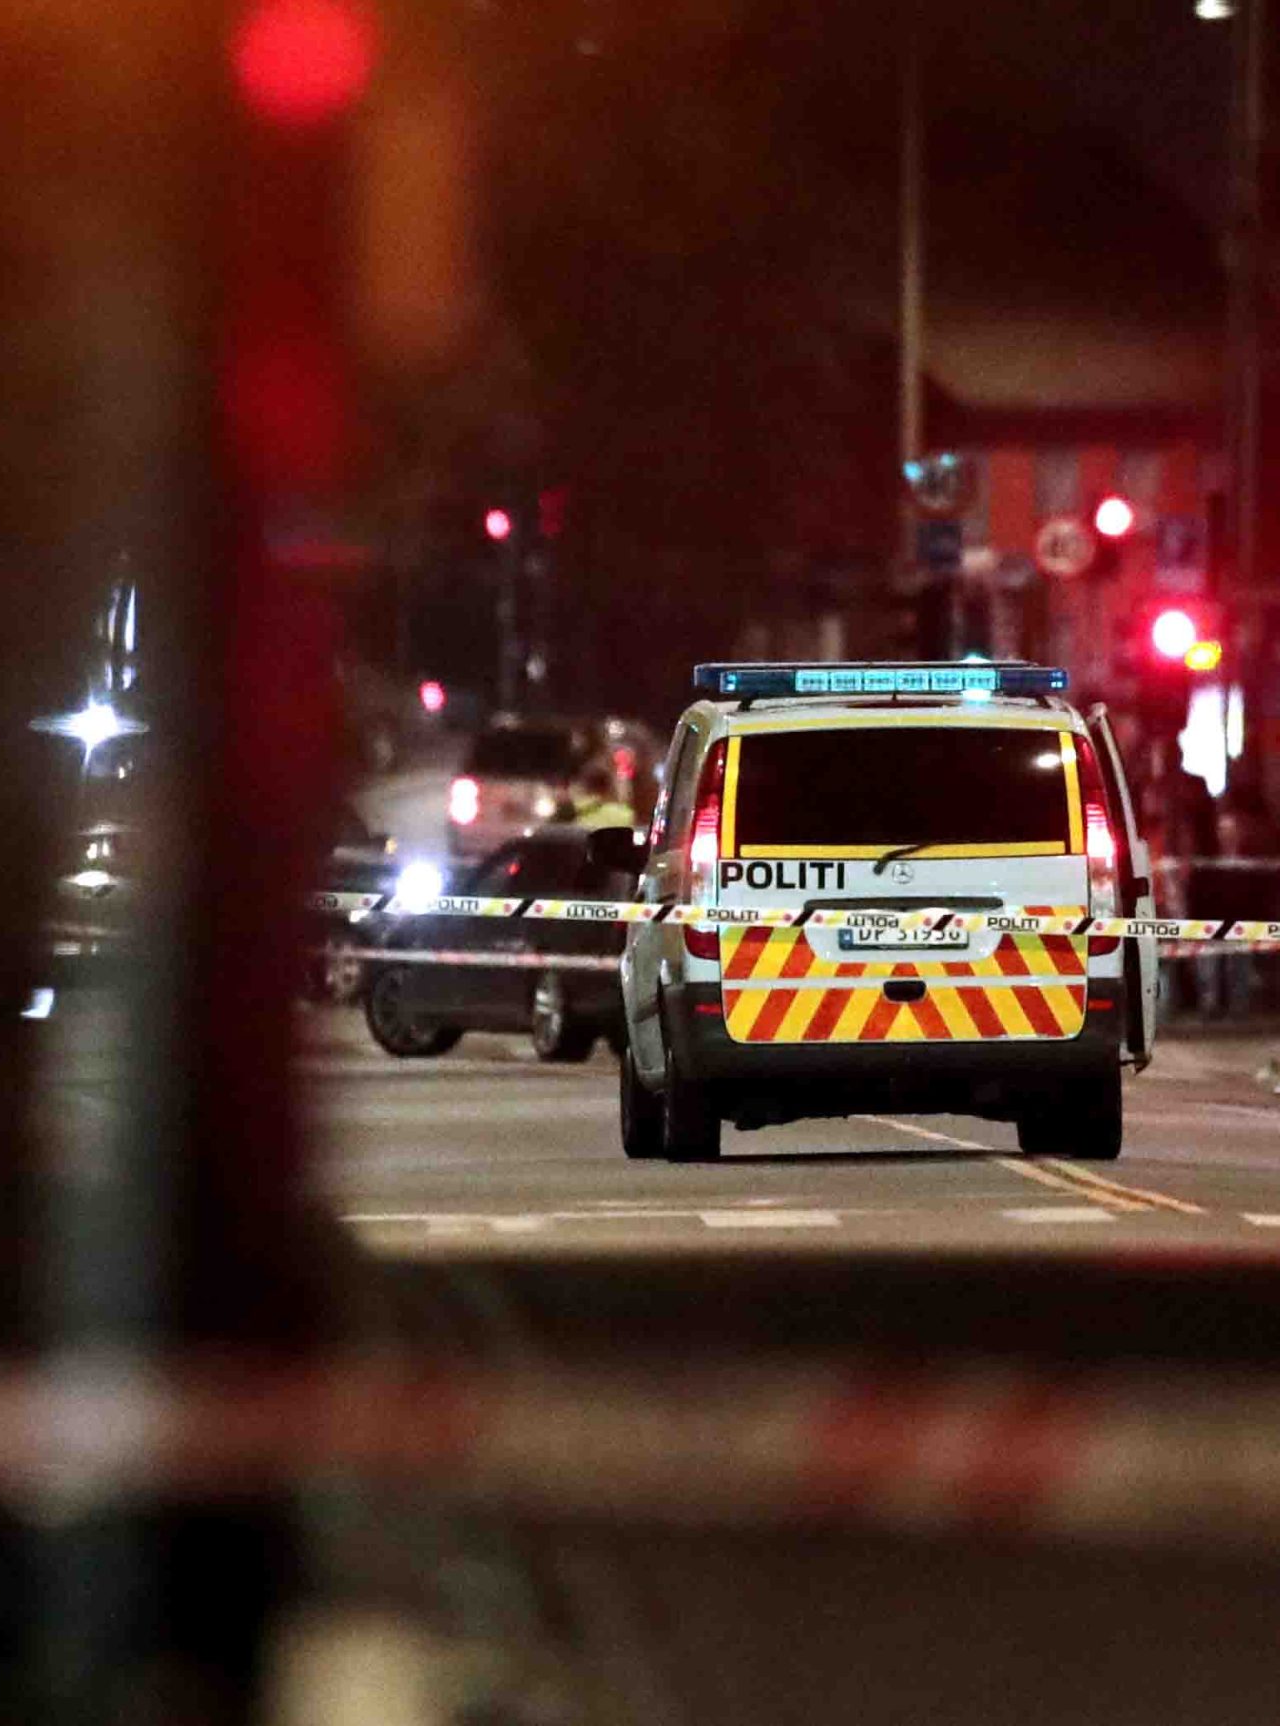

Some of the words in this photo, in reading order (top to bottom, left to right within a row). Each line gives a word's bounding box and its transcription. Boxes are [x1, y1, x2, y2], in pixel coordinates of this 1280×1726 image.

[720, 861, 845, 889] POLITI
[566, 907, 619, 919] POLITI
[706, 908, 759, 920] POLITI
[846, 916, 899, 929] POLITI
[987, 917, 1039, 929] POLITI
[1127, 923, 1180, 936] POLITI
